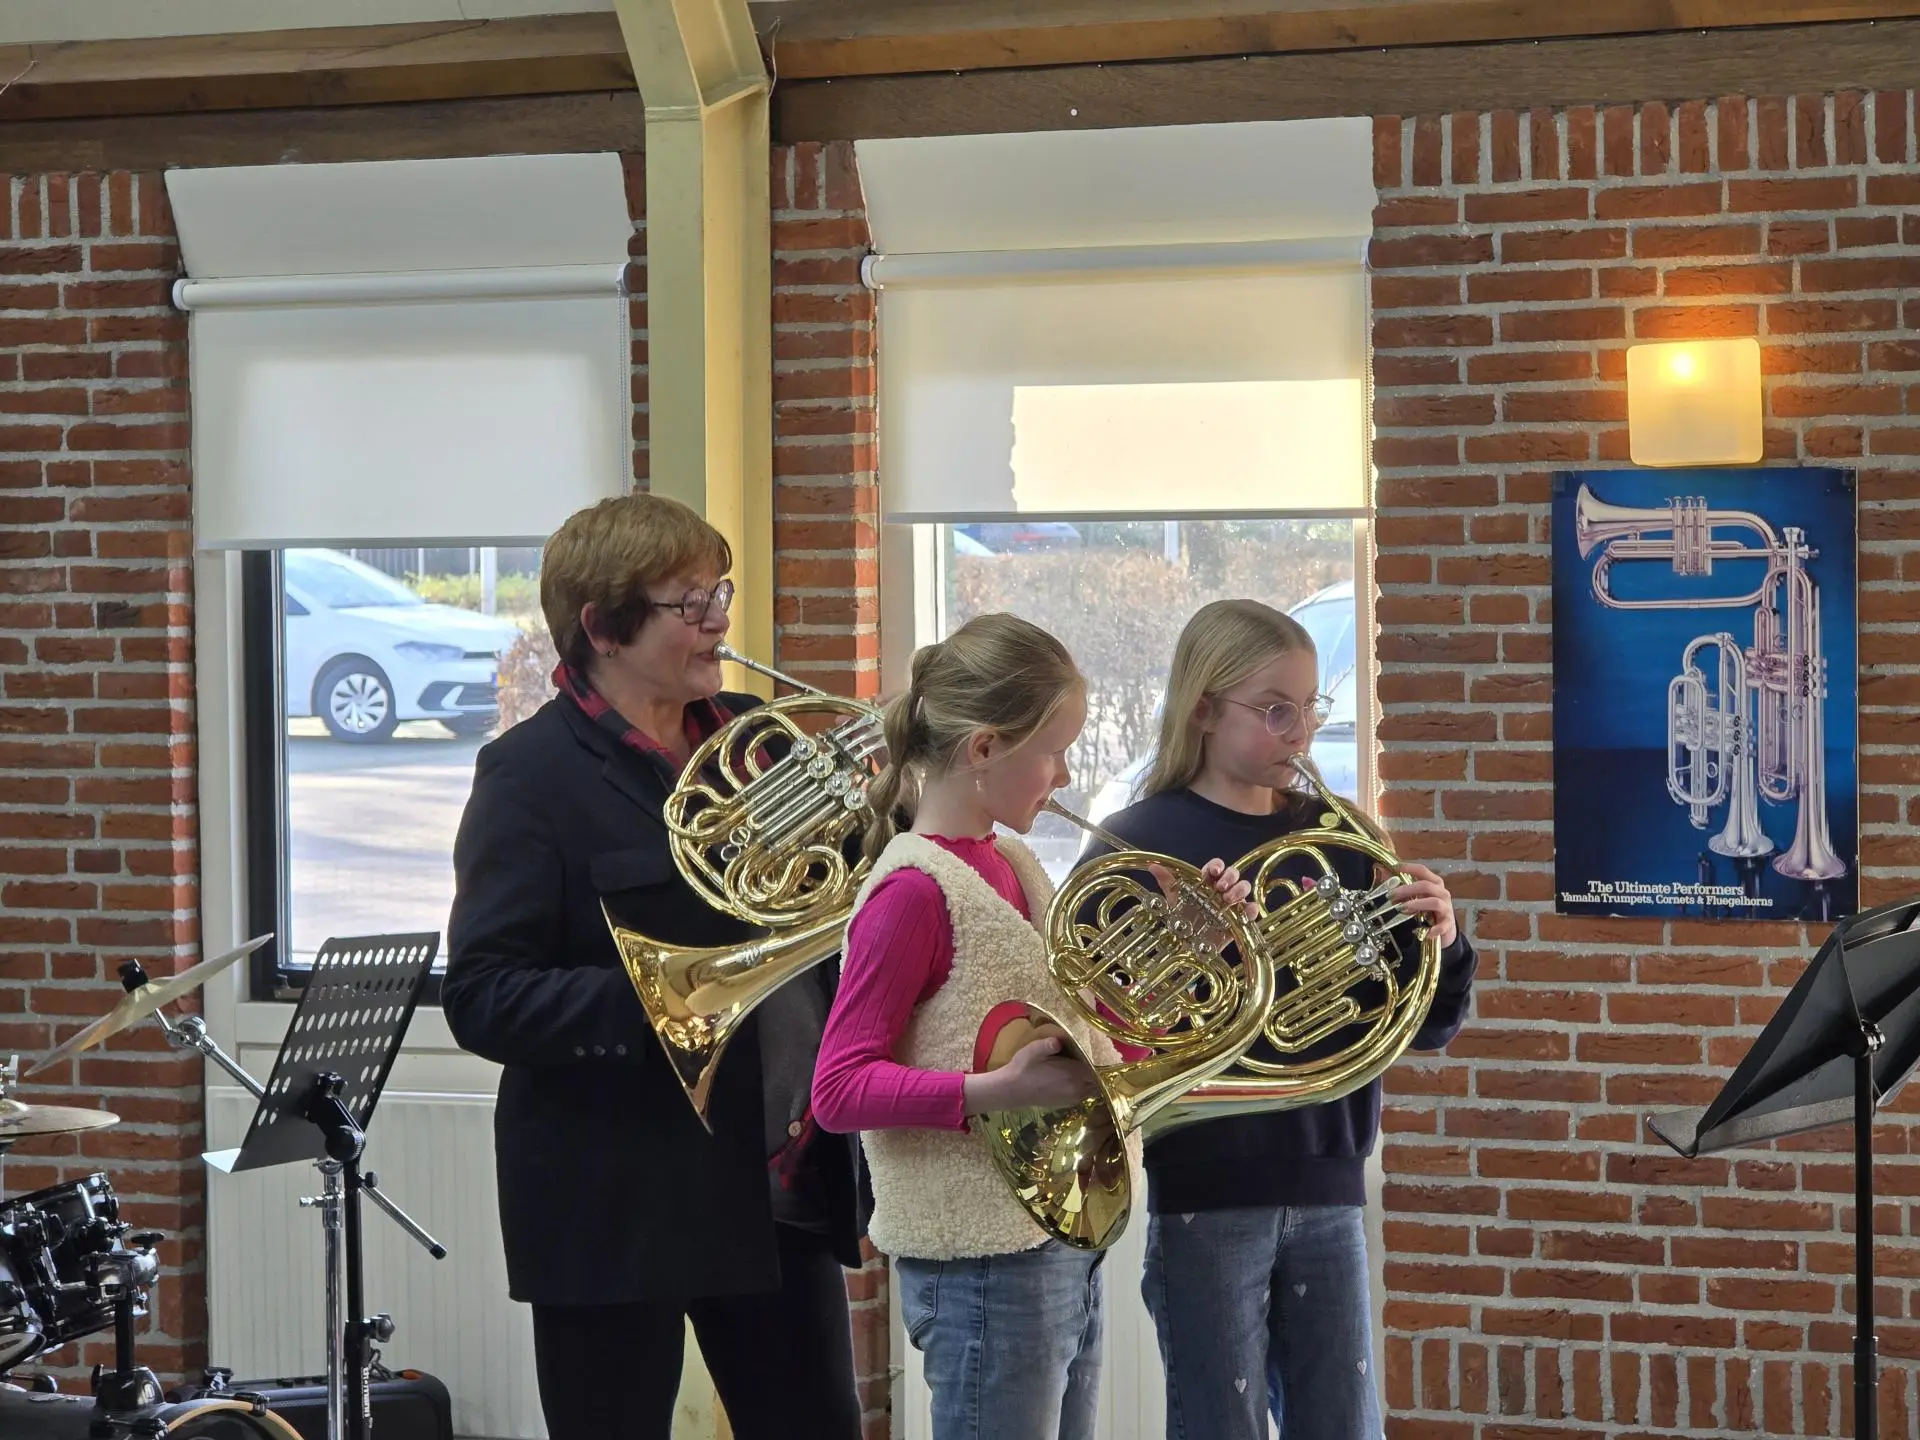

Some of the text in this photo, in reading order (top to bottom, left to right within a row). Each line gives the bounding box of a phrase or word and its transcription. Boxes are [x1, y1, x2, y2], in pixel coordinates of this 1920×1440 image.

[1587, 880, 1744, 895] The Ultimate Performers
[1561, 892, 1773, 908] Yamaha Trumpets, Cornets & Fluegelhorns
